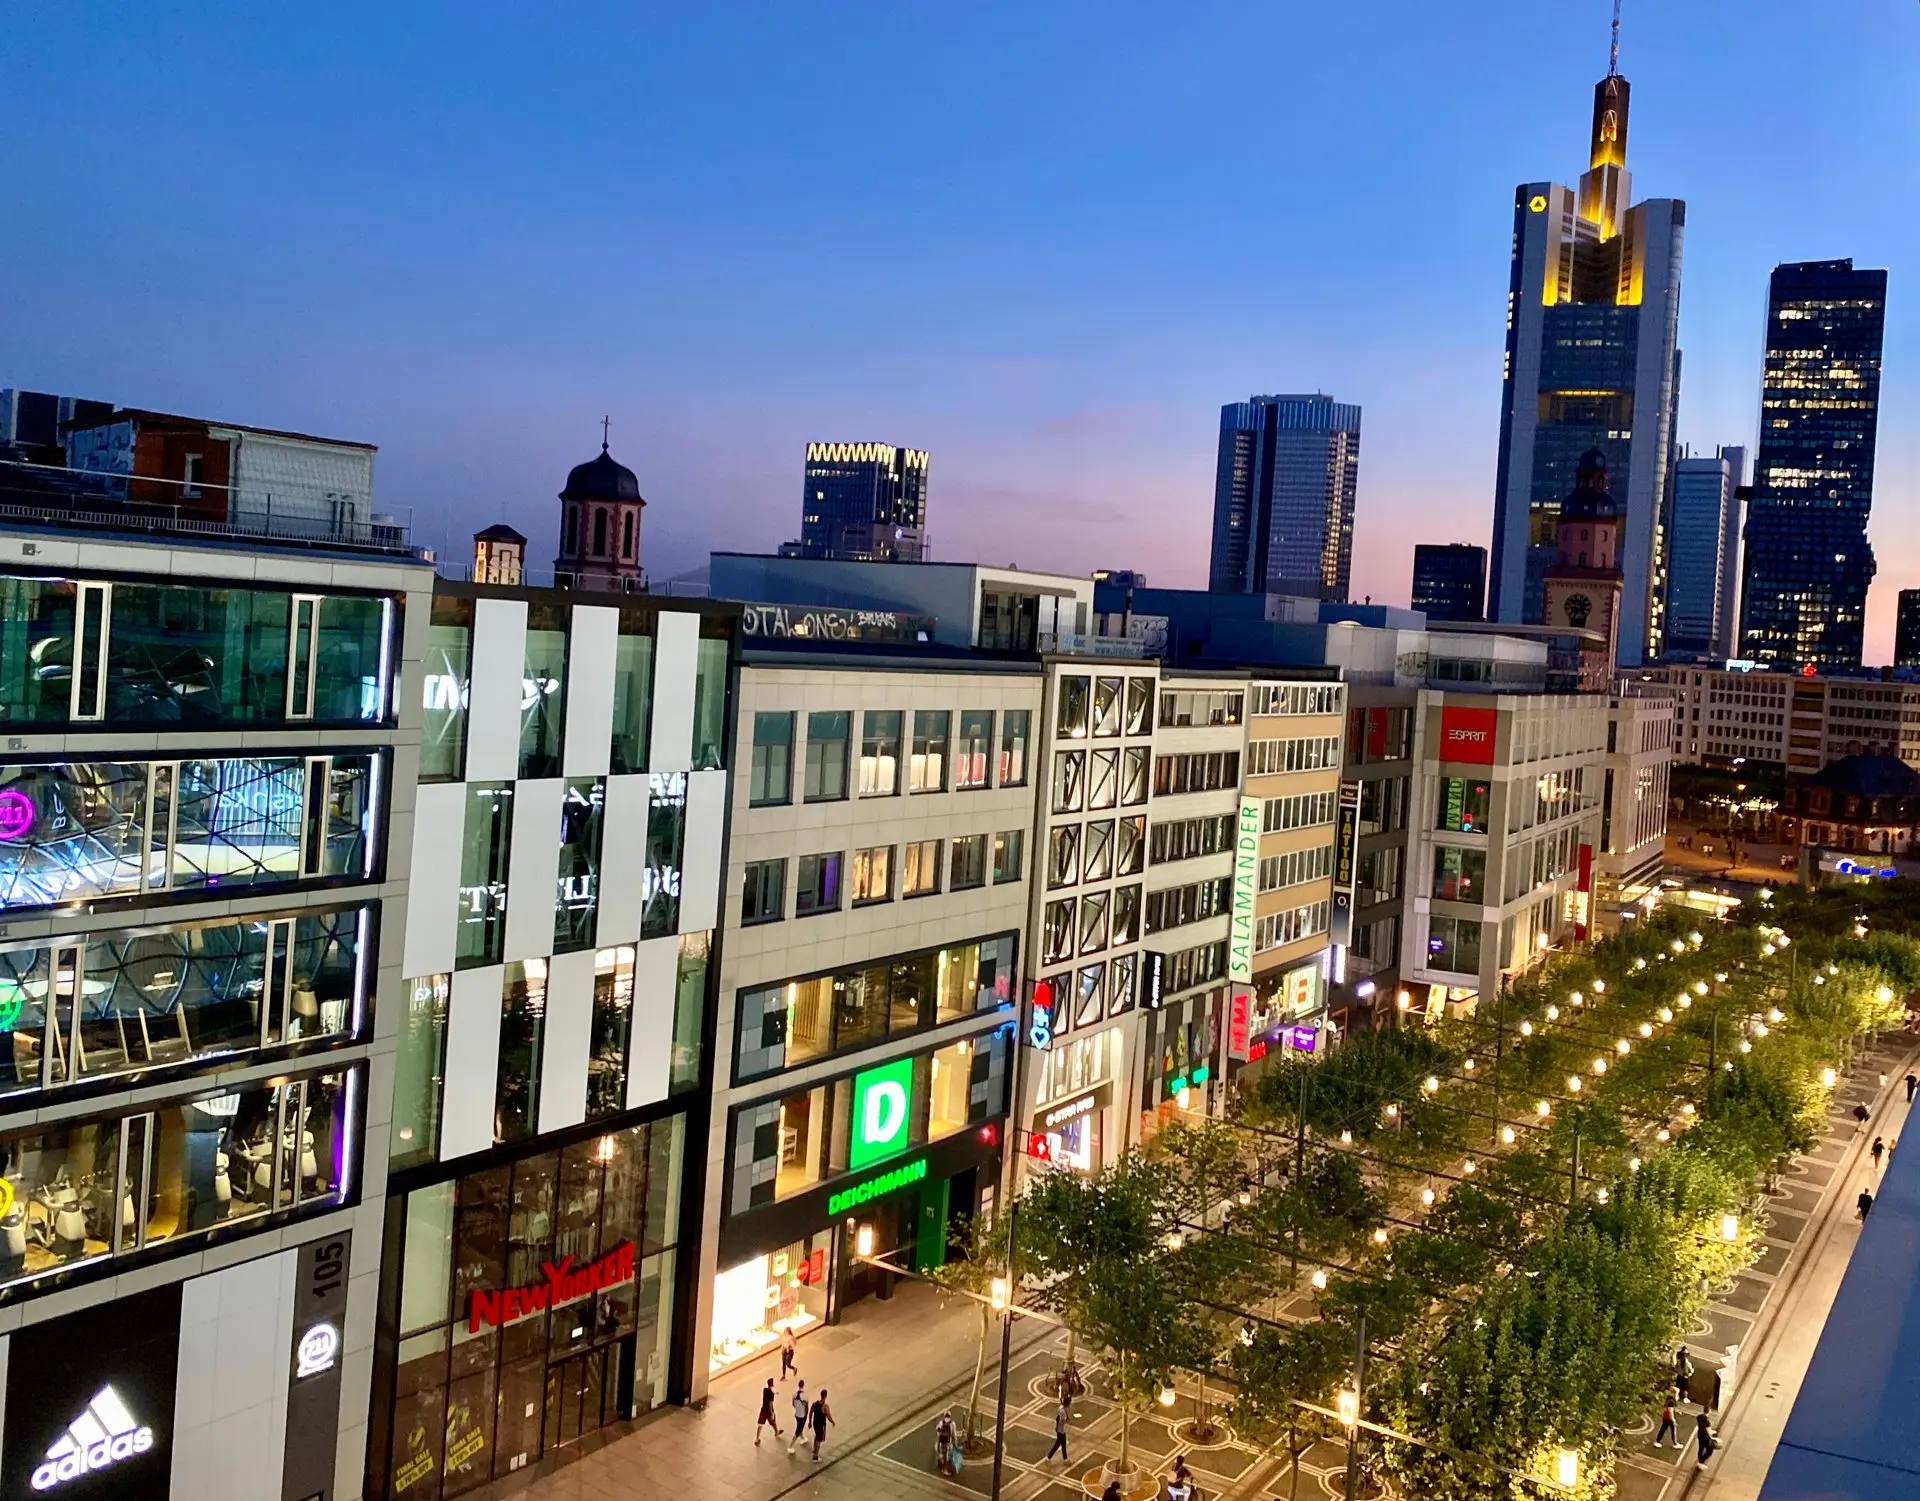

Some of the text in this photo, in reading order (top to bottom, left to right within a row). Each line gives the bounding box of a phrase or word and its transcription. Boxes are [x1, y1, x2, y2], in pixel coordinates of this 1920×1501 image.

[1449, 729, 1487, 742] ESPRIT
[1341, 811, 1352, 882] TATTOO
[1231, 806, 1259, 973] SALAMANDER
[1232, 993, 1249, 1052] HEMA
[863, 1081, 907, 1144] D
[829, 1159, 926, 1215] DEICHMANN
[313, 1242, 345, 1299] 105
[30, 1426, 154, 1491] adidas
